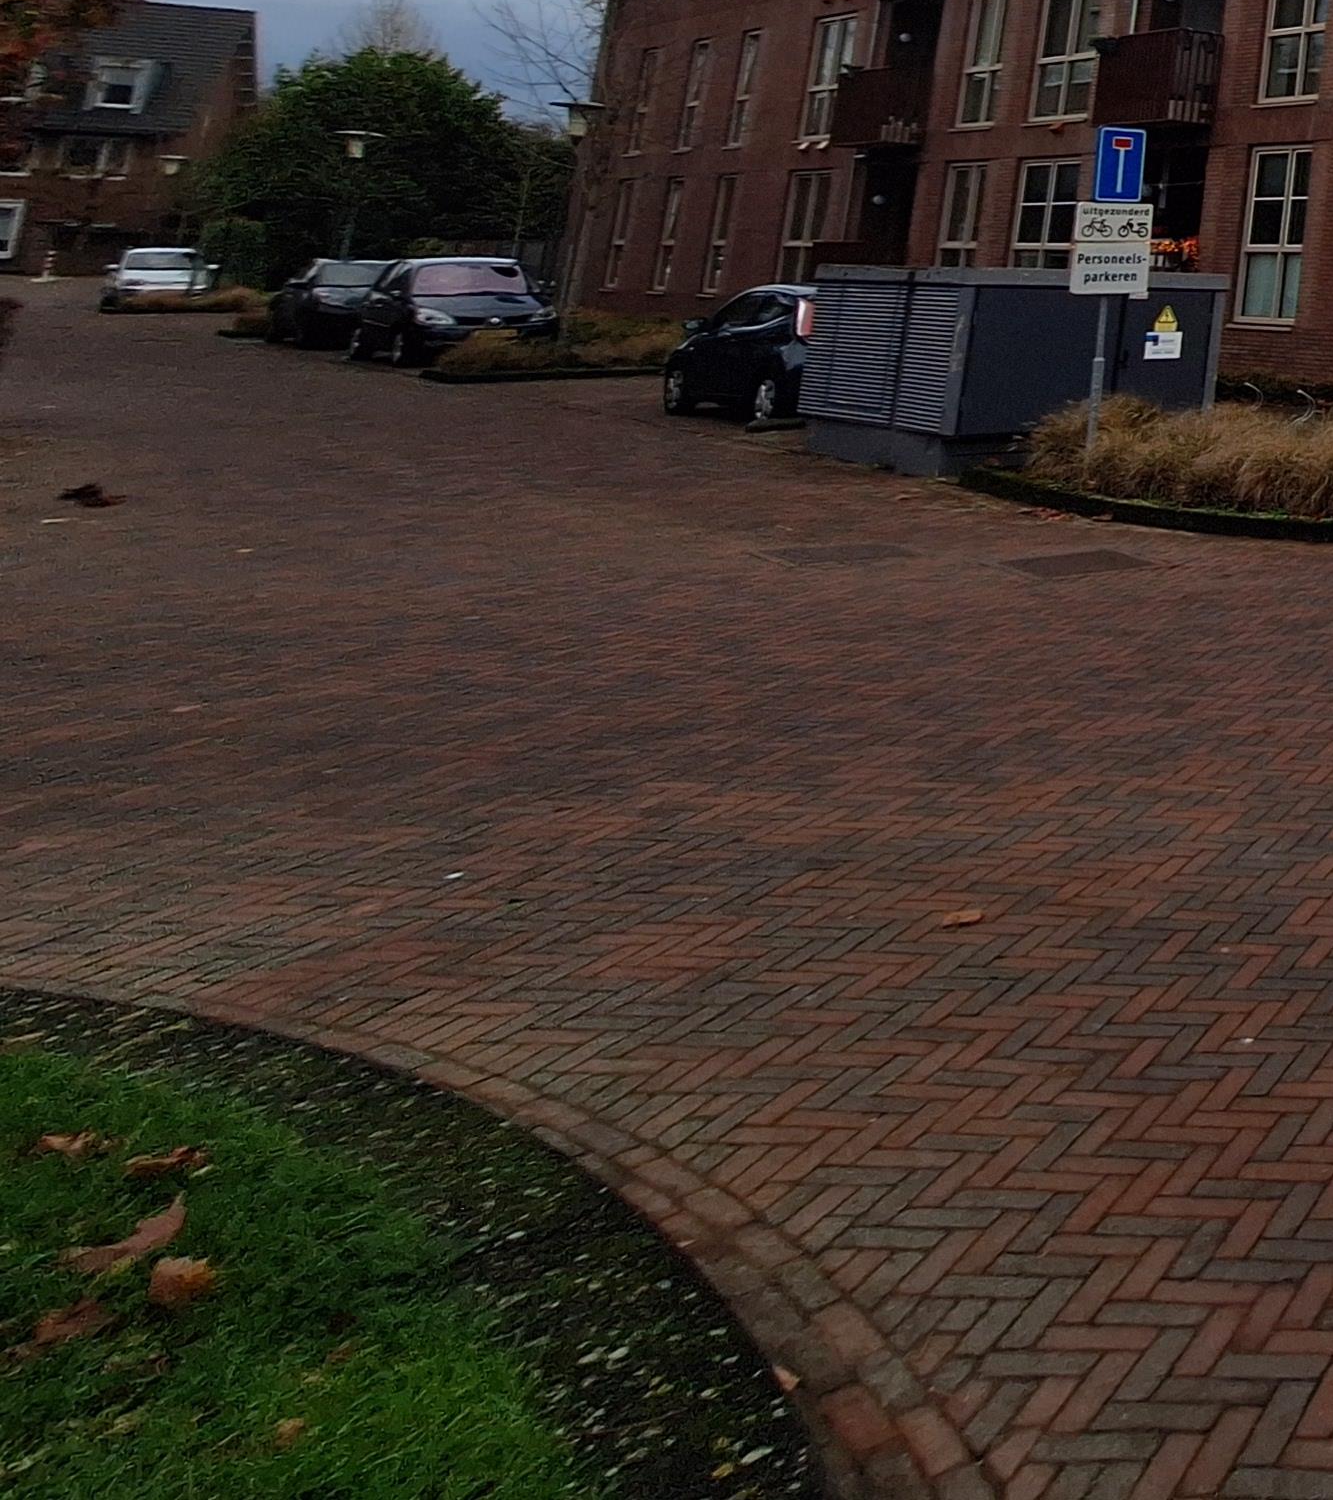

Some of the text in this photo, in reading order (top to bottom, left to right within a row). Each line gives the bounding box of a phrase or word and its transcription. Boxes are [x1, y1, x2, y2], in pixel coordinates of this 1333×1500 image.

[1083, 207, 1150, 217] uitgezonderd
[1077, 253, 1147, 265] Personeels-
[1083, 271, 1137, 285] parkeren
